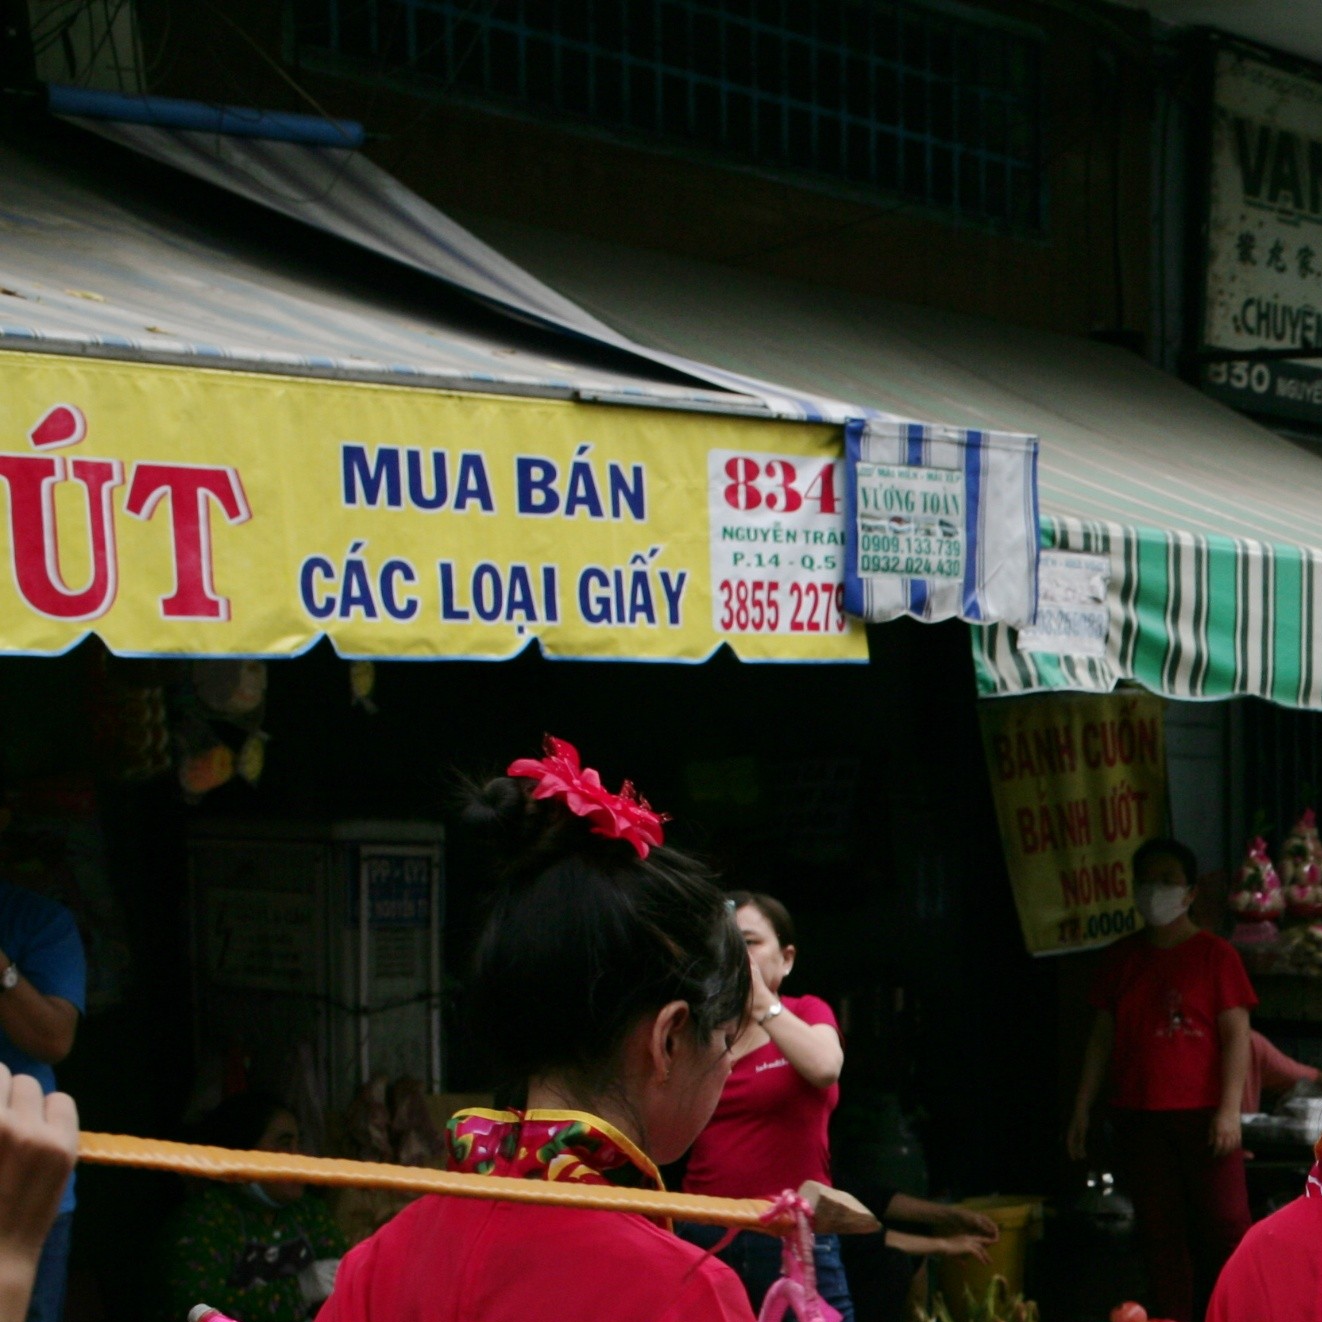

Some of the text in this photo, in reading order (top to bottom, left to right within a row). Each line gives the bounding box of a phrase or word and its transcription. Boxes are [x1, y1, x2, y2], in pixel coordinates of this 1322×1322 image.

[340, 443, 647, 521] MUA BÁN
[723, 456, 842, 515] 834
[721, 520, 798, 545] NGUYỄN
[861, 534, 962, 558] 0909.133.739
[300, 541, 687, 635] CÁC LOẠI GIẤY
[732, 551, 781, 568] P.14
[801, 553, 837, 572] Q.5
[719, 578, 846, 633] 3855 2279
[990, 701, 1159, 781] BÁNH CUỐN
[1017, 788, 1092, 855] BÁNH
[1060, 854, 1128, 909] NÓNG
